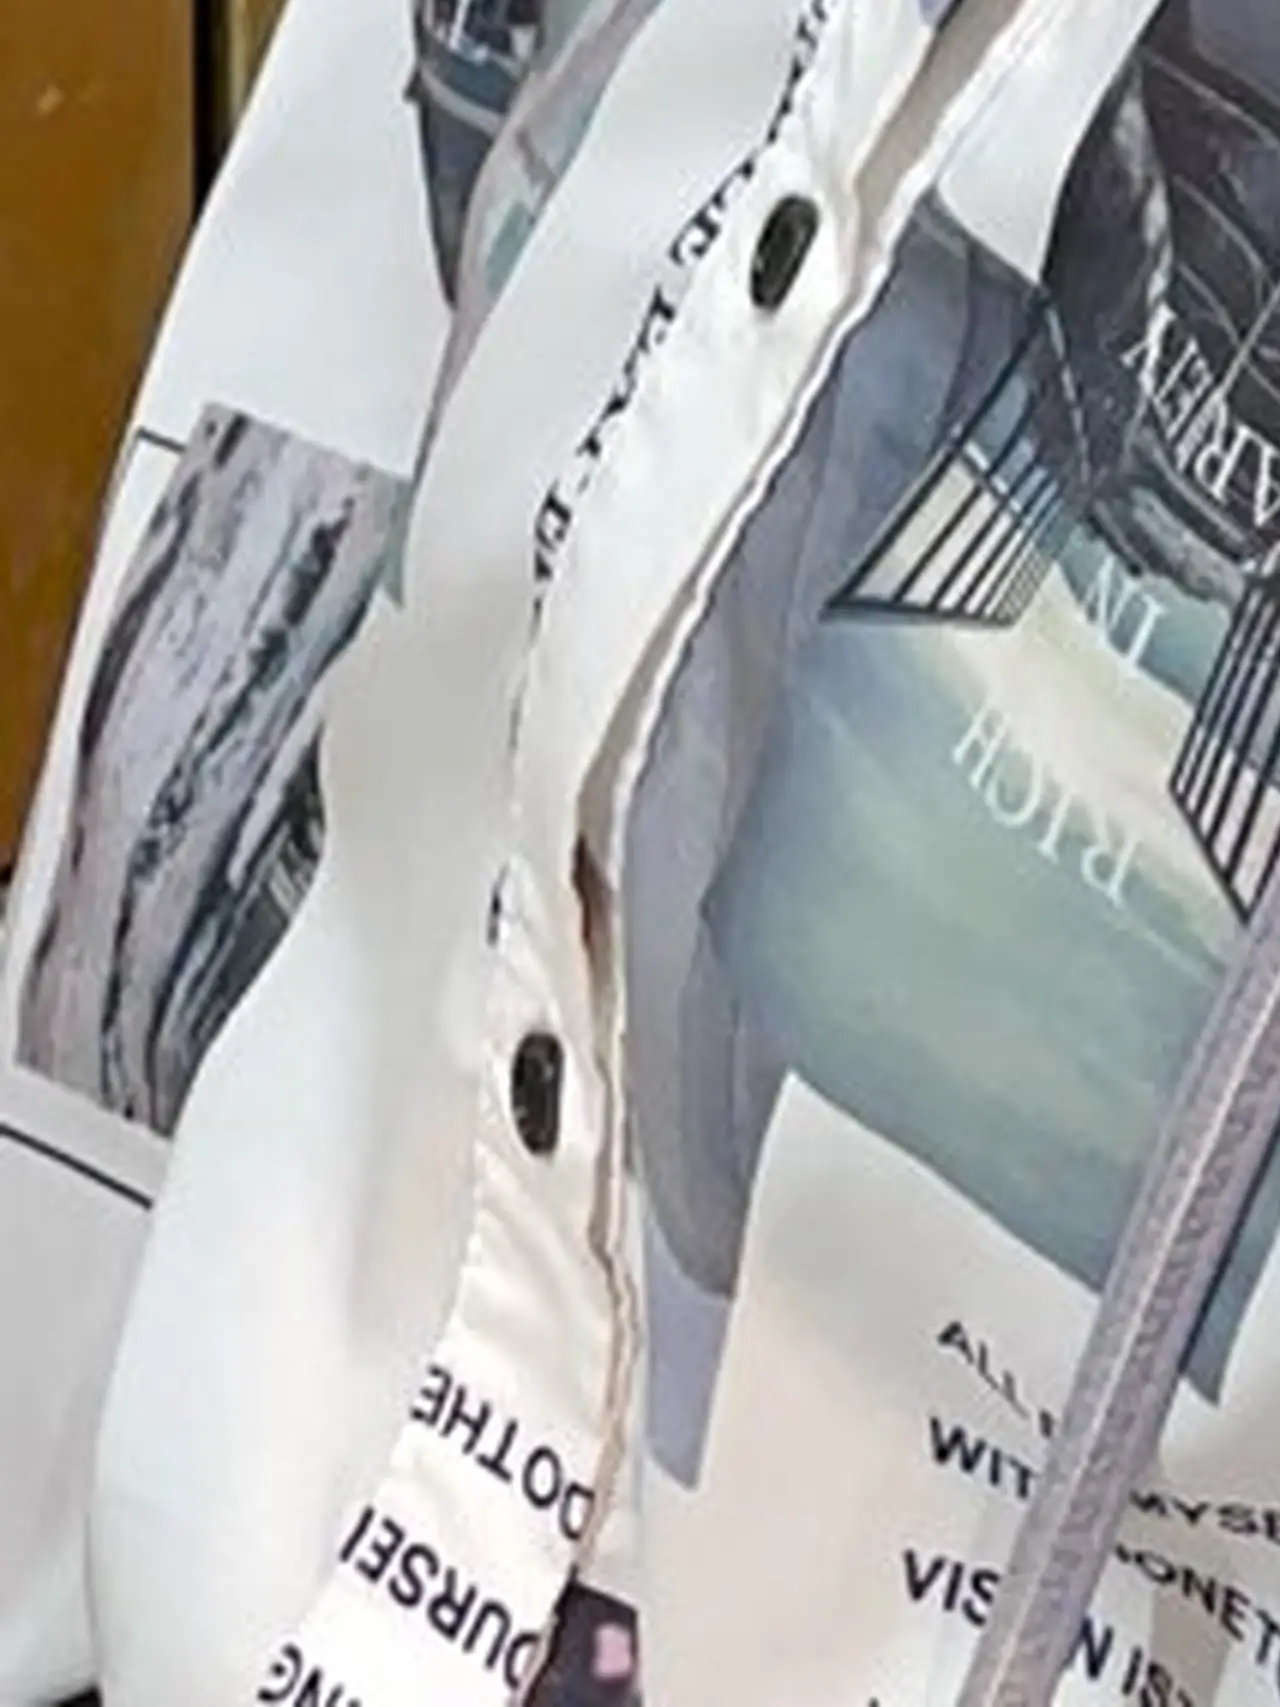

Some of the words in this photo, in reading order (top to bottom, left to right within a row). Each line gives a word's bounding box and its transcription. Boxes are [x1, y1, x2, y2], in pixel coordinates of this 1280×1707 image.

[1081, 560, 1172, 680] IN
[950, 698, 1144, 910] RICH
[936, 1320, 1031, 1419] ALL
[926, 1416, 1037, 1502] WIT
[903, 1548, 1114, 1681] VISN
